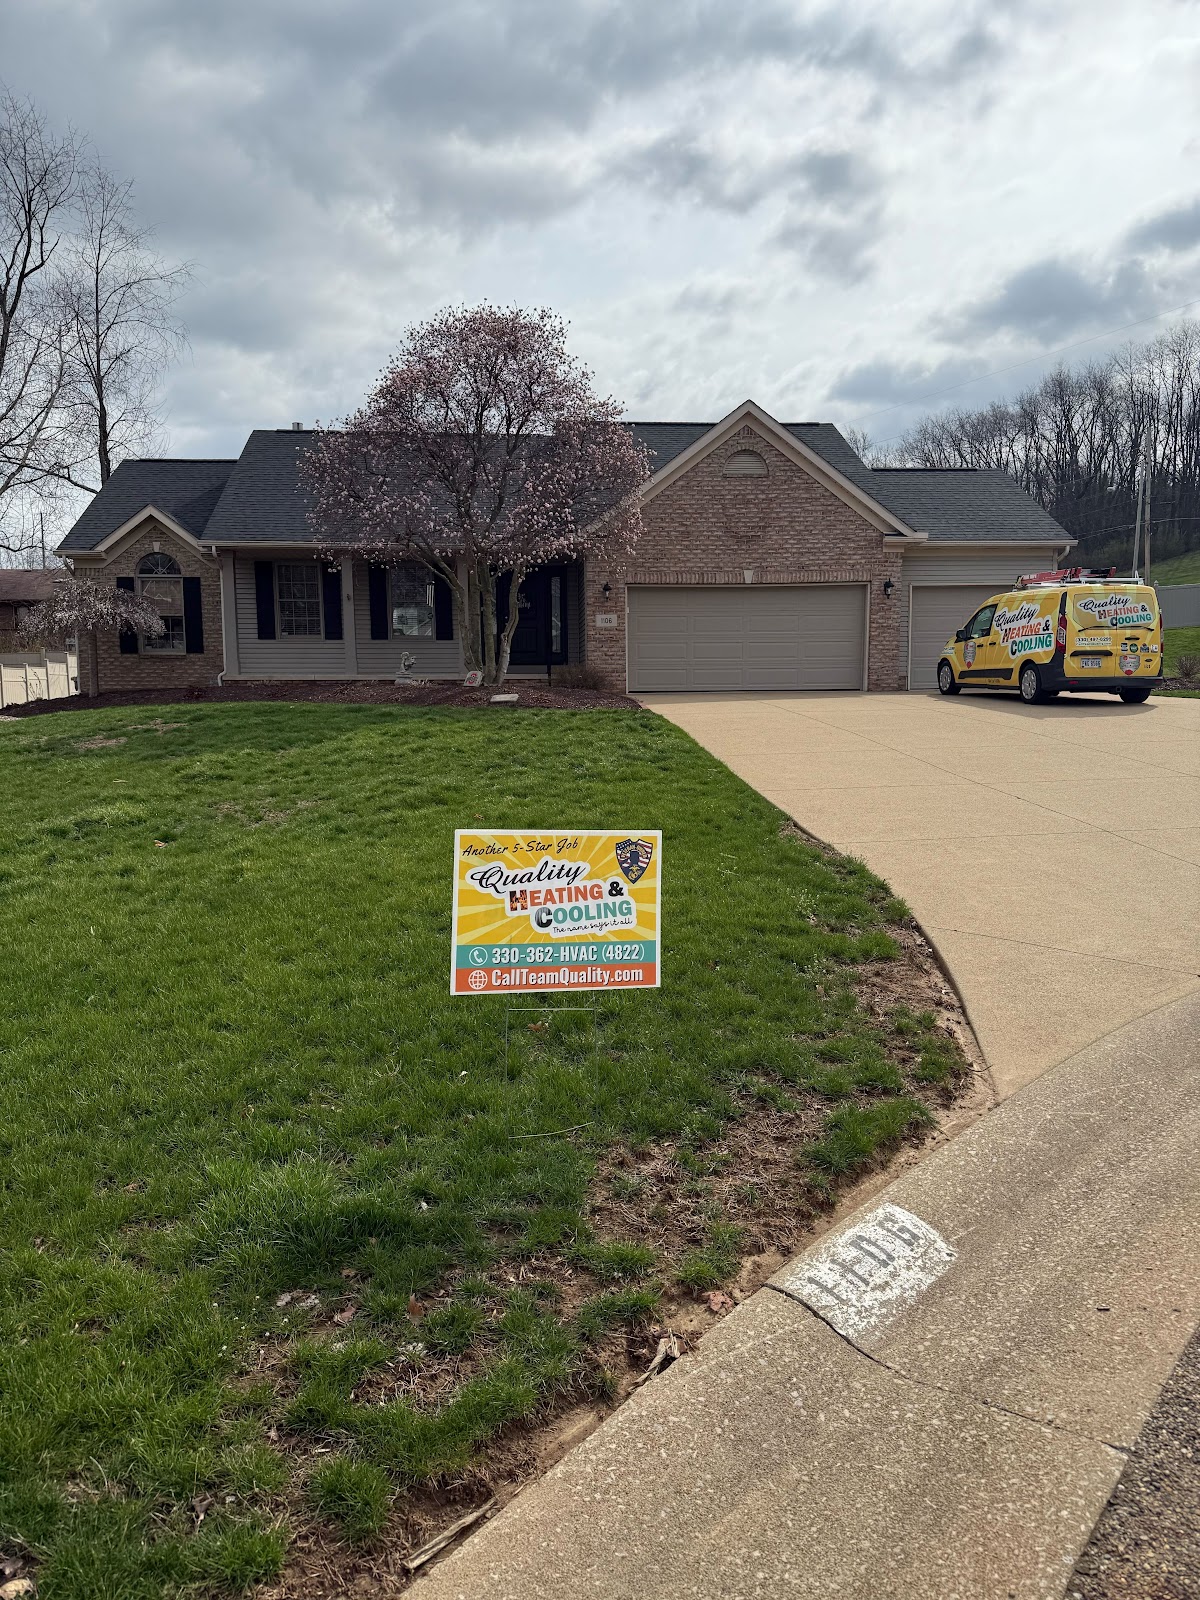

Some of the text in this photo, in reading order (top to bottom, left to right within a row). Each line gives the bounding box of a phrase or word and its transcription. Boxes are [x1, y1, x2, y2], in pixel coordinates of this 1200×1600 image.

[1079, 596, 1130, 612] Quality
[1098, 606, 1139, 619] HEATING
[994, 605, 1038, 631] Quality
[1110, 614, 1152, 626] COOLING
[1002, 620, 1050, 643] HEATING &
[1011, 634, 1052, 655] COOLING
[462, 838, 579, 857] Another 5-Star Job
[470, 860, 587, 894] Quality
[509, 881, 624, 911] HEATING &
[535, 900, 632, 928] COOLING
[590, 921, 609, 931] says
[619, 917, 633, 925] all
[492, 943, 644, 964] 330-362-HVAC (4822)
[492, 967, 643, 986] CallTeamQuality.com
